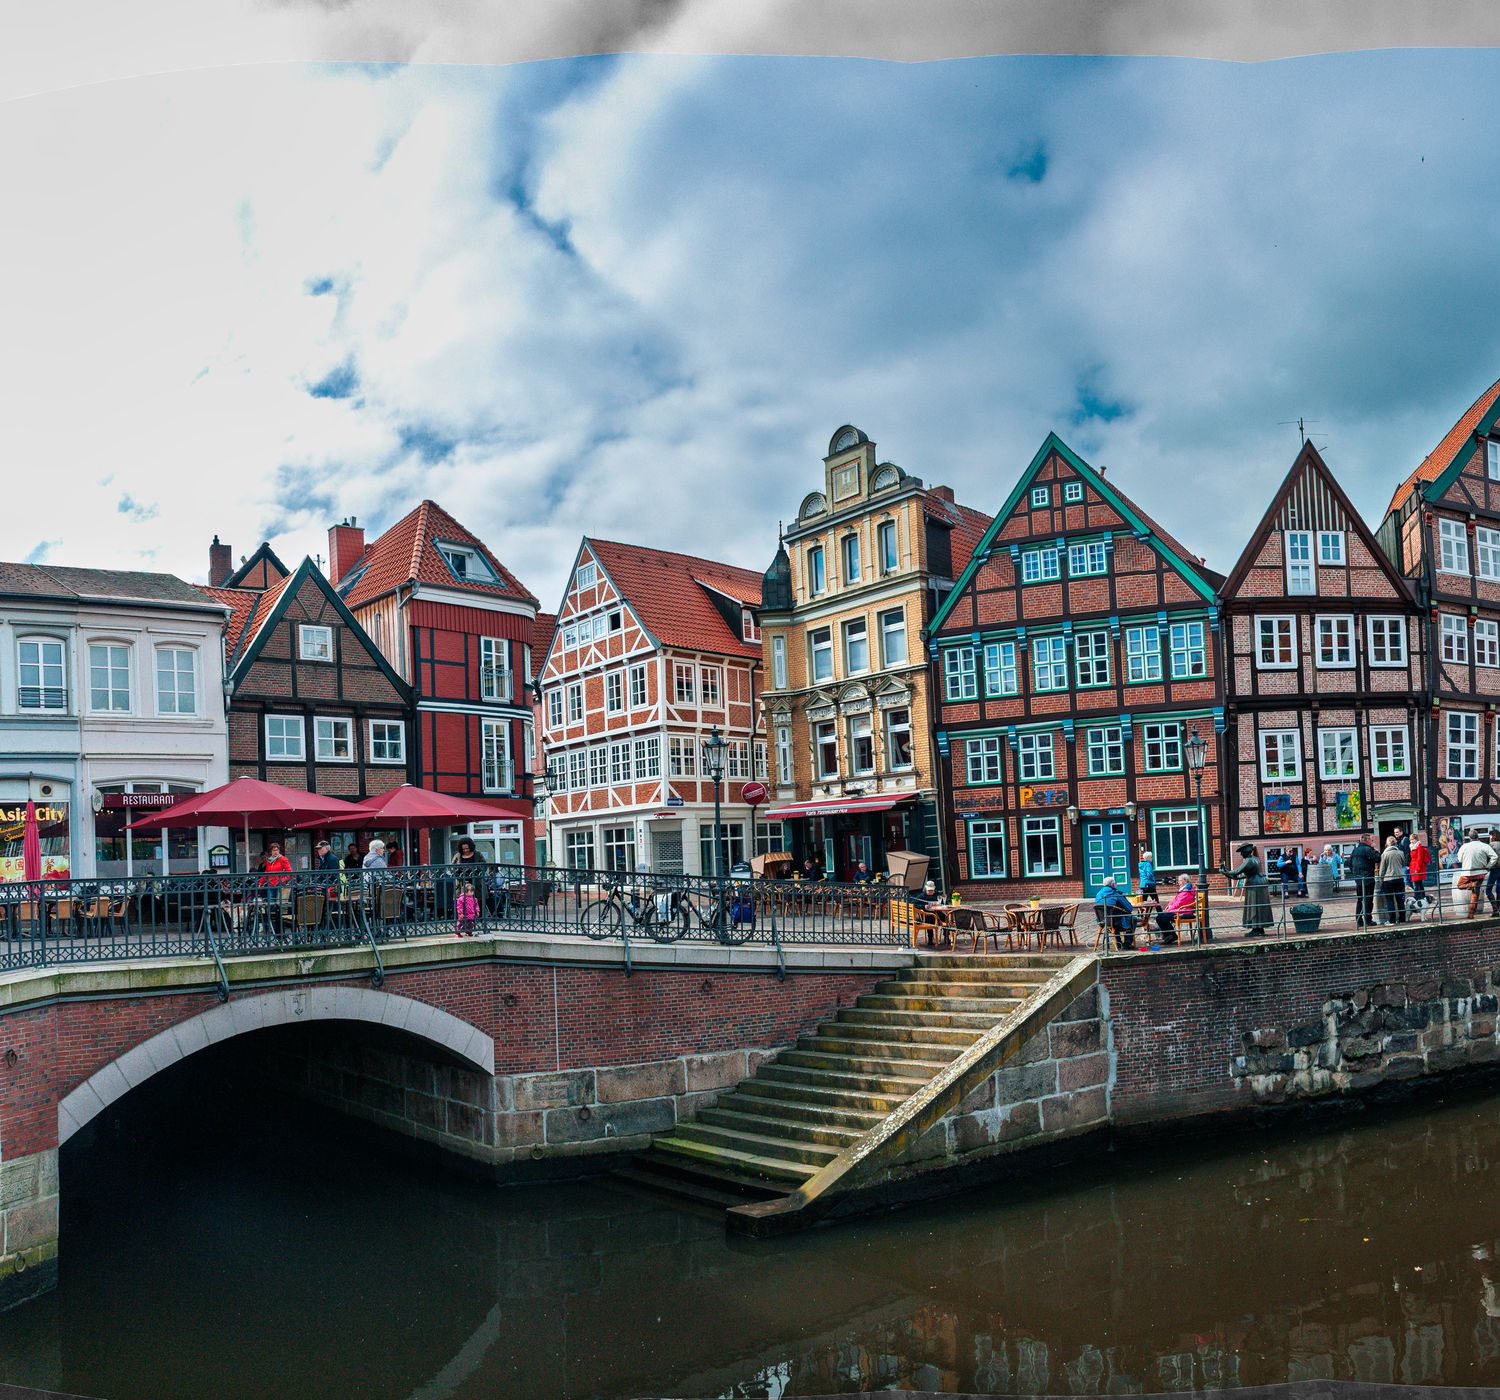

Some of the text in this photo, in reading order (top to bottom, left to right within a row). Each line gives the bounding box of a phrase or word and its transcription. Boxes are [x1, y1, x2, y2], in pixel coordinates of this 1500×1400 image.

[122, 795, 175, 805] RESTAURANT
[1020, 786, 1068, 806] Pera
[35, 807, 65, 823] City
